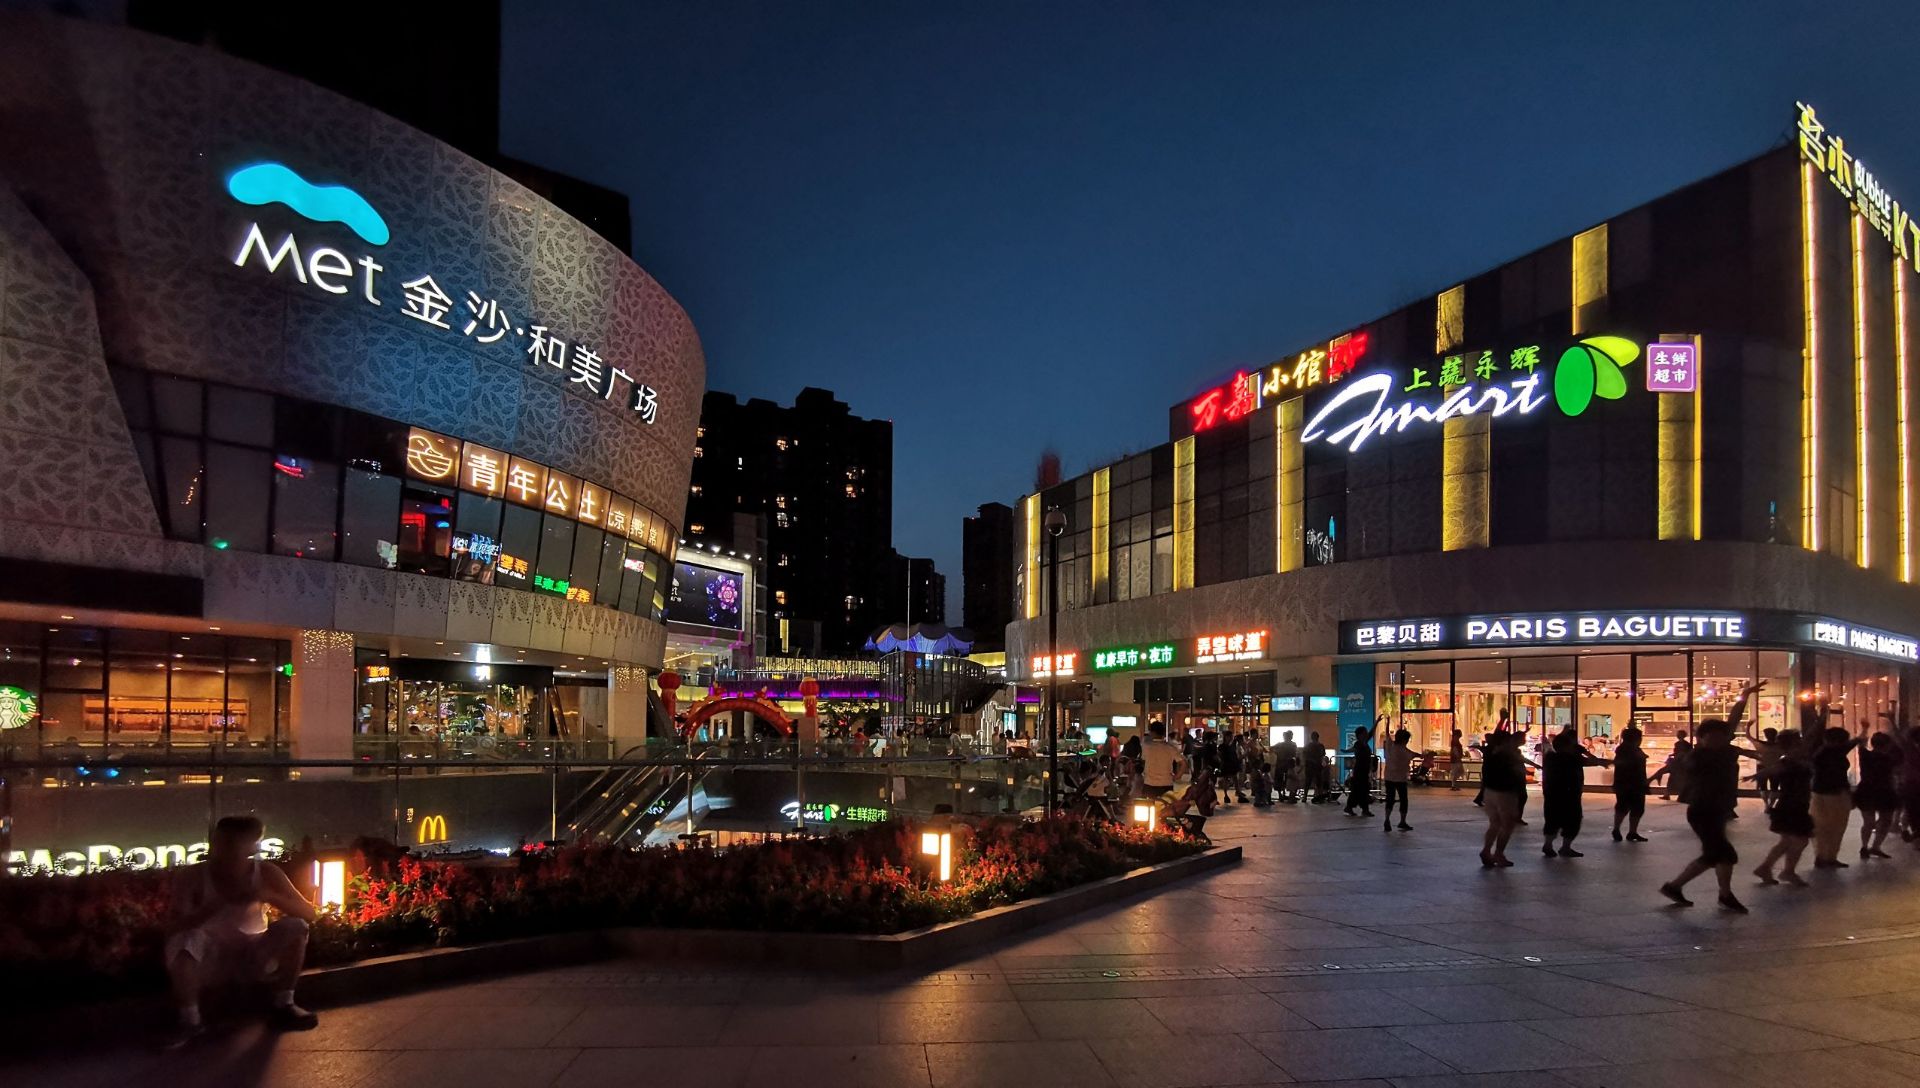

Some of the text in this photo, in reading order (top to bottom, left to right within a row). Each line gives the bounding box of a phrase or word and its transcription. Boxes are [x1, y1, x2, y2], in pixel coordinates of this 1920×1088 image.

[234, 222, 383, 306] Met
[1404, 344, 1541, 393] 上蔬永辉
[1653, 350, 1689, 367] 生鲜
[1653, 368, 1689, 384] 超市
[1197, 632, 1262, 656] 弄堂味道
[1356, 616, 1743, 646] 巴黎贝甜 PARIS BAGUETTE
